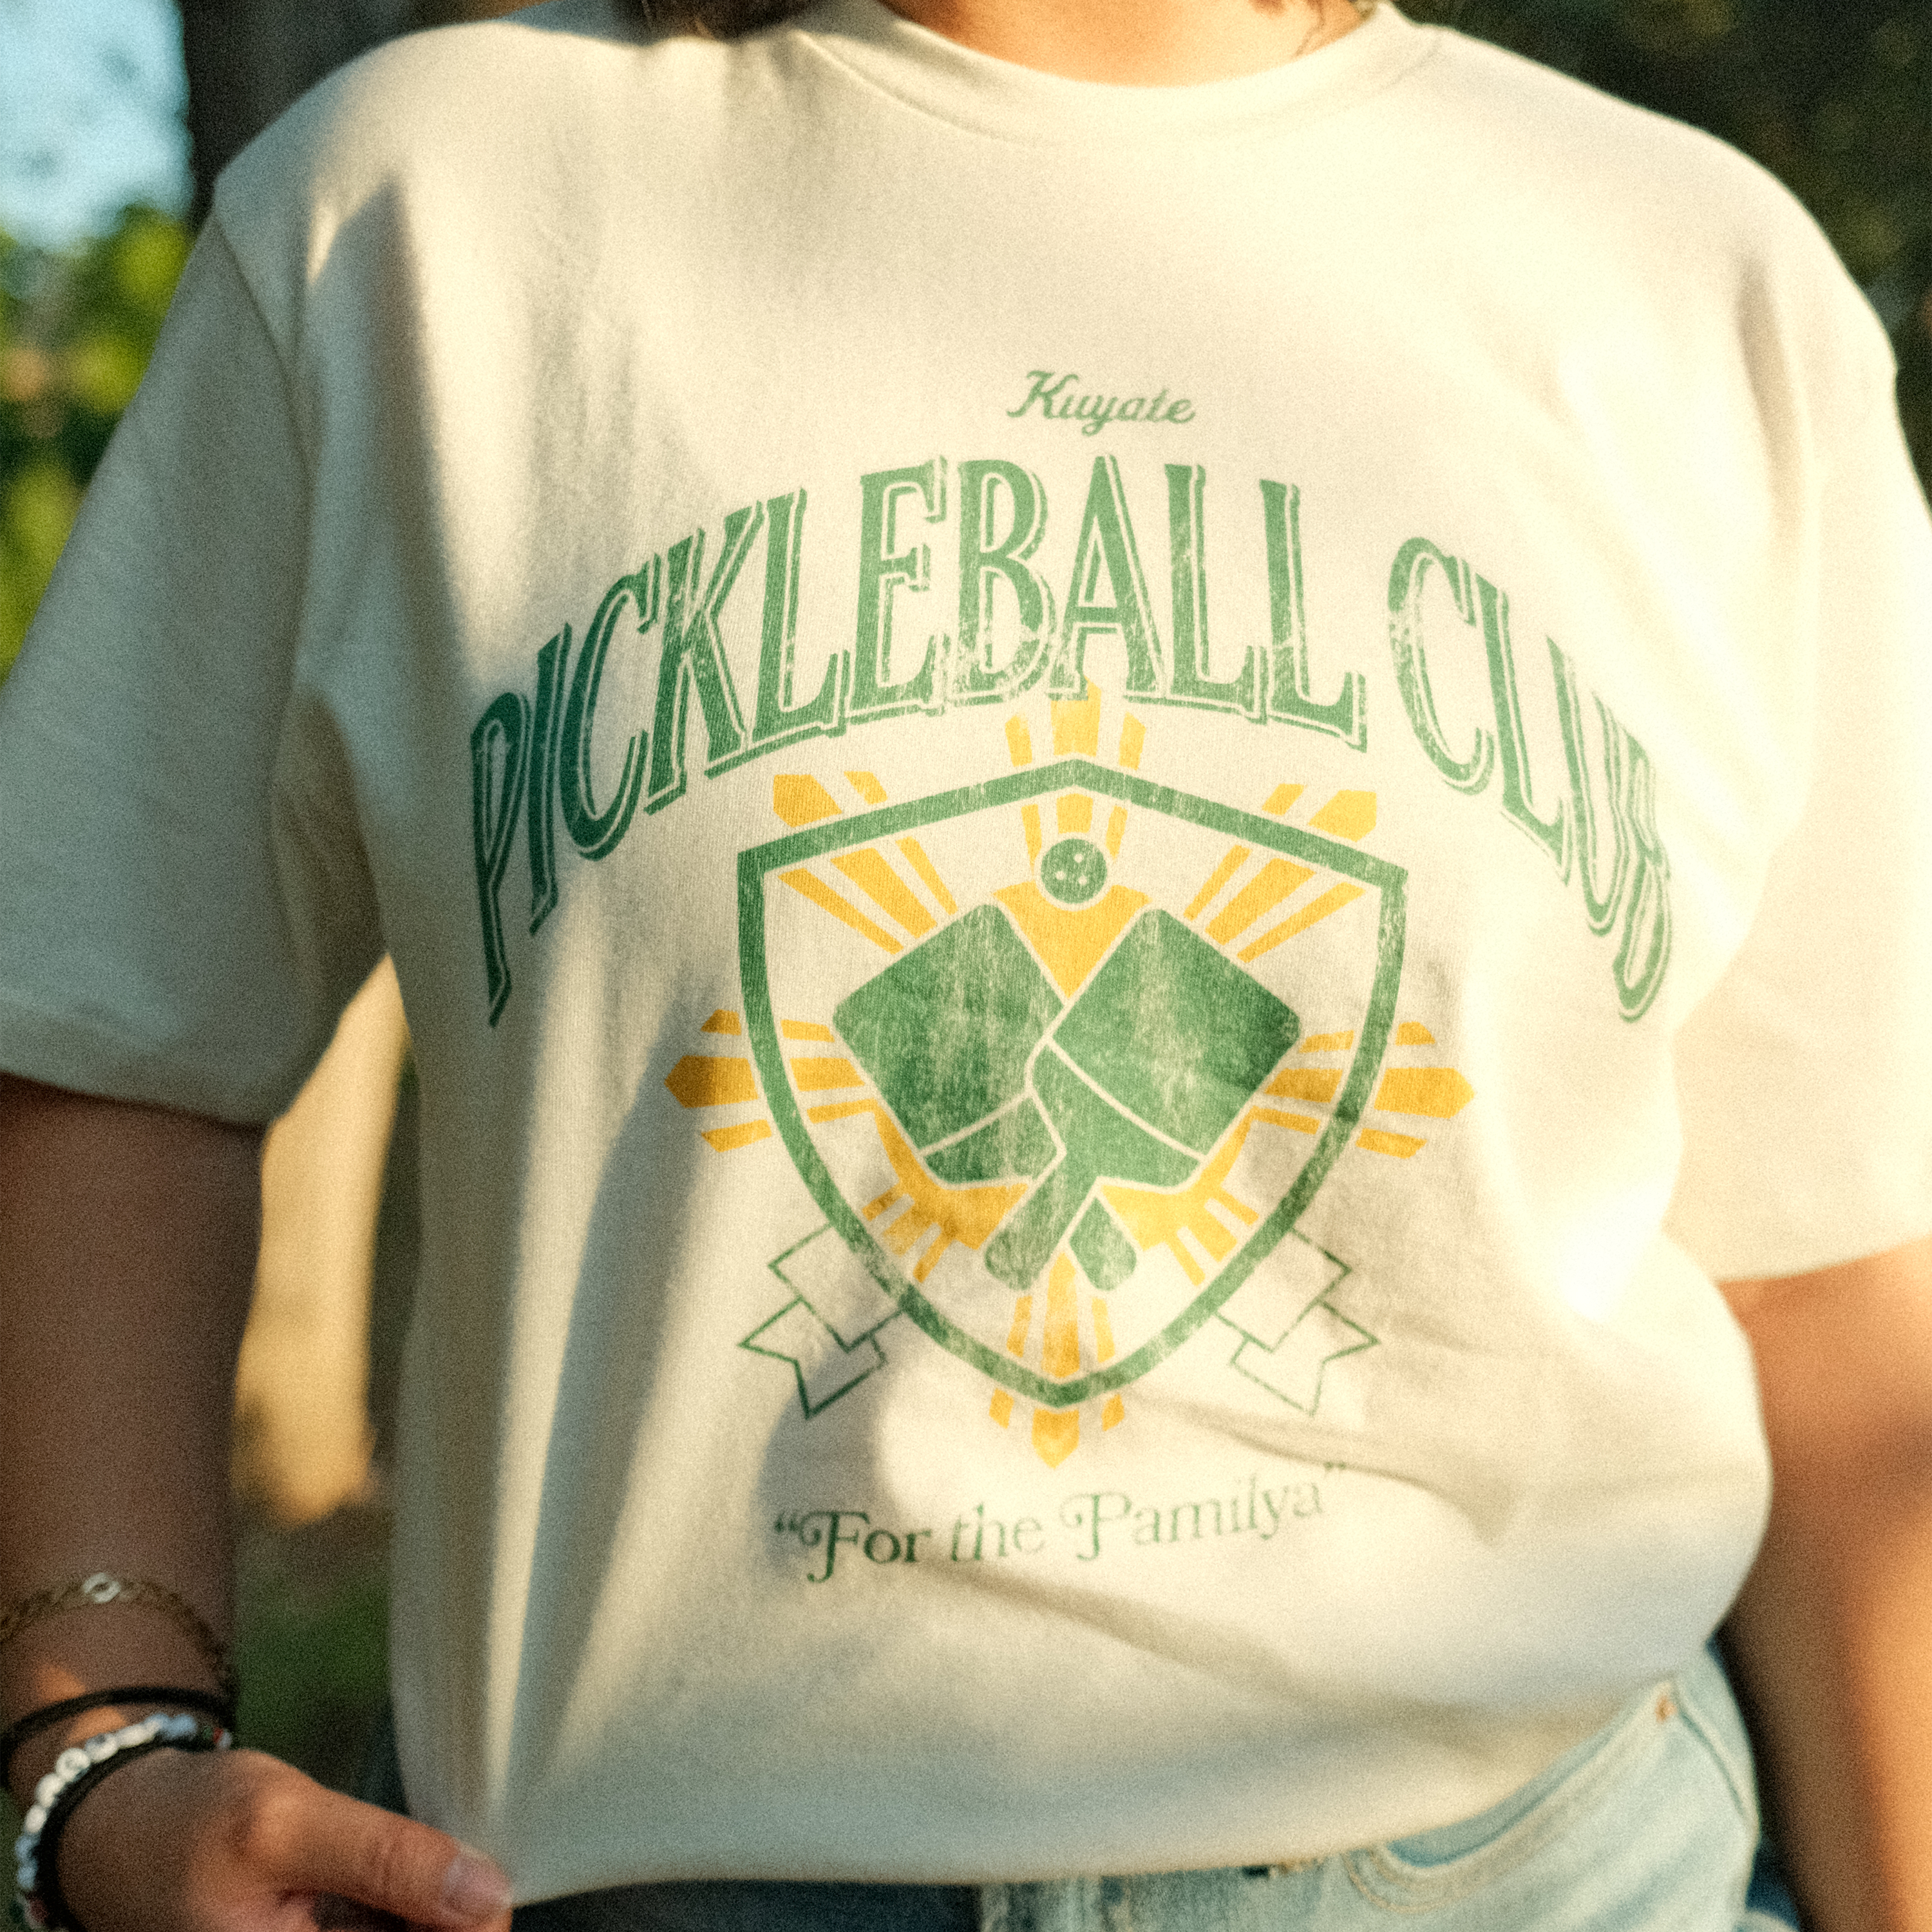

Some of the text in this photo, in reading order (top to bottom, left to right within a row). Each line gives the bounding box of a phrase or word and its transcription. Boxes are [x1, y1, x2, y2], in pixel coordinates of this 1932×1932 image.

[1007, 370, 1196, 437] Kuyate
[470, 455, 1672, 1027] PICKLEBALL CLUB
[950, 1502, 1046, 1564] the
